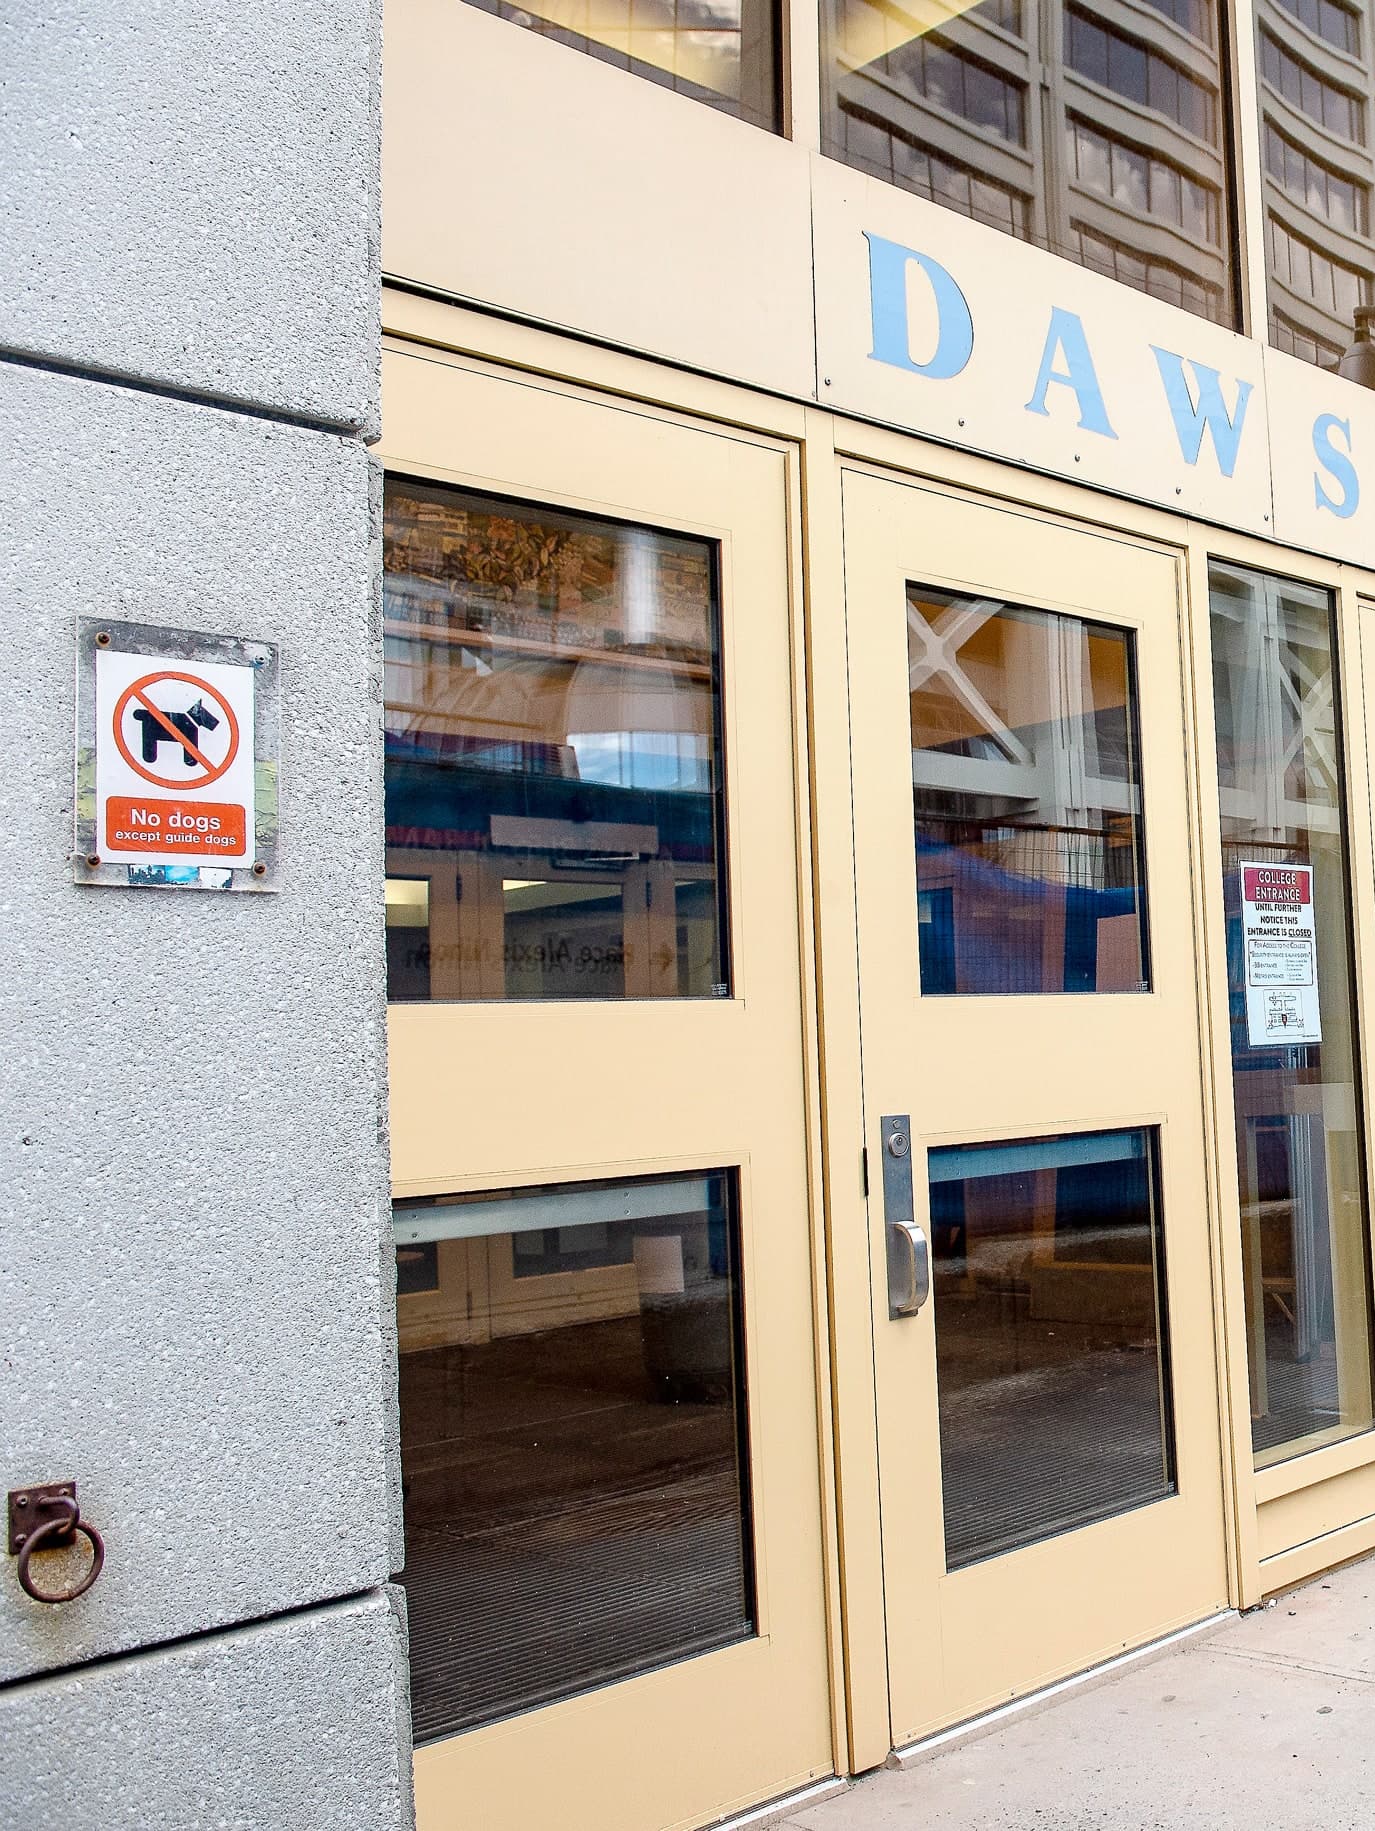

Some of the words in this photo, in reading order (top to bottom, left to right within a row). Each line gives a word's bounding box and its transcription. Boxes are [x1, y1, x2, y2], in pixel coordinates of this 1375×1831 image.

[131, 808, 160, 826] No
[168, 811, 221, 832] dogs
[115, 830, 160, 842] except
[165, 832, 200, 844] guide
[204, 834, 236, 846] dogs
[1258, 870, 1296, 885] COLLEGE
[1255, 886, 1301, 901] ENTRANCE
[1255, 903, 1273, 911] UNTIL
[1274, 904, 1302, 913] FURTHER
[1260, 916, 1283, 924] NOTICE
[1284, 916, 1298, 925] THIS
[1247, 928, 1280, 936] ENTRANCE
[1281, 928, 1287, 936] IS
[1288, 929, 1312, 937] CLOSED
